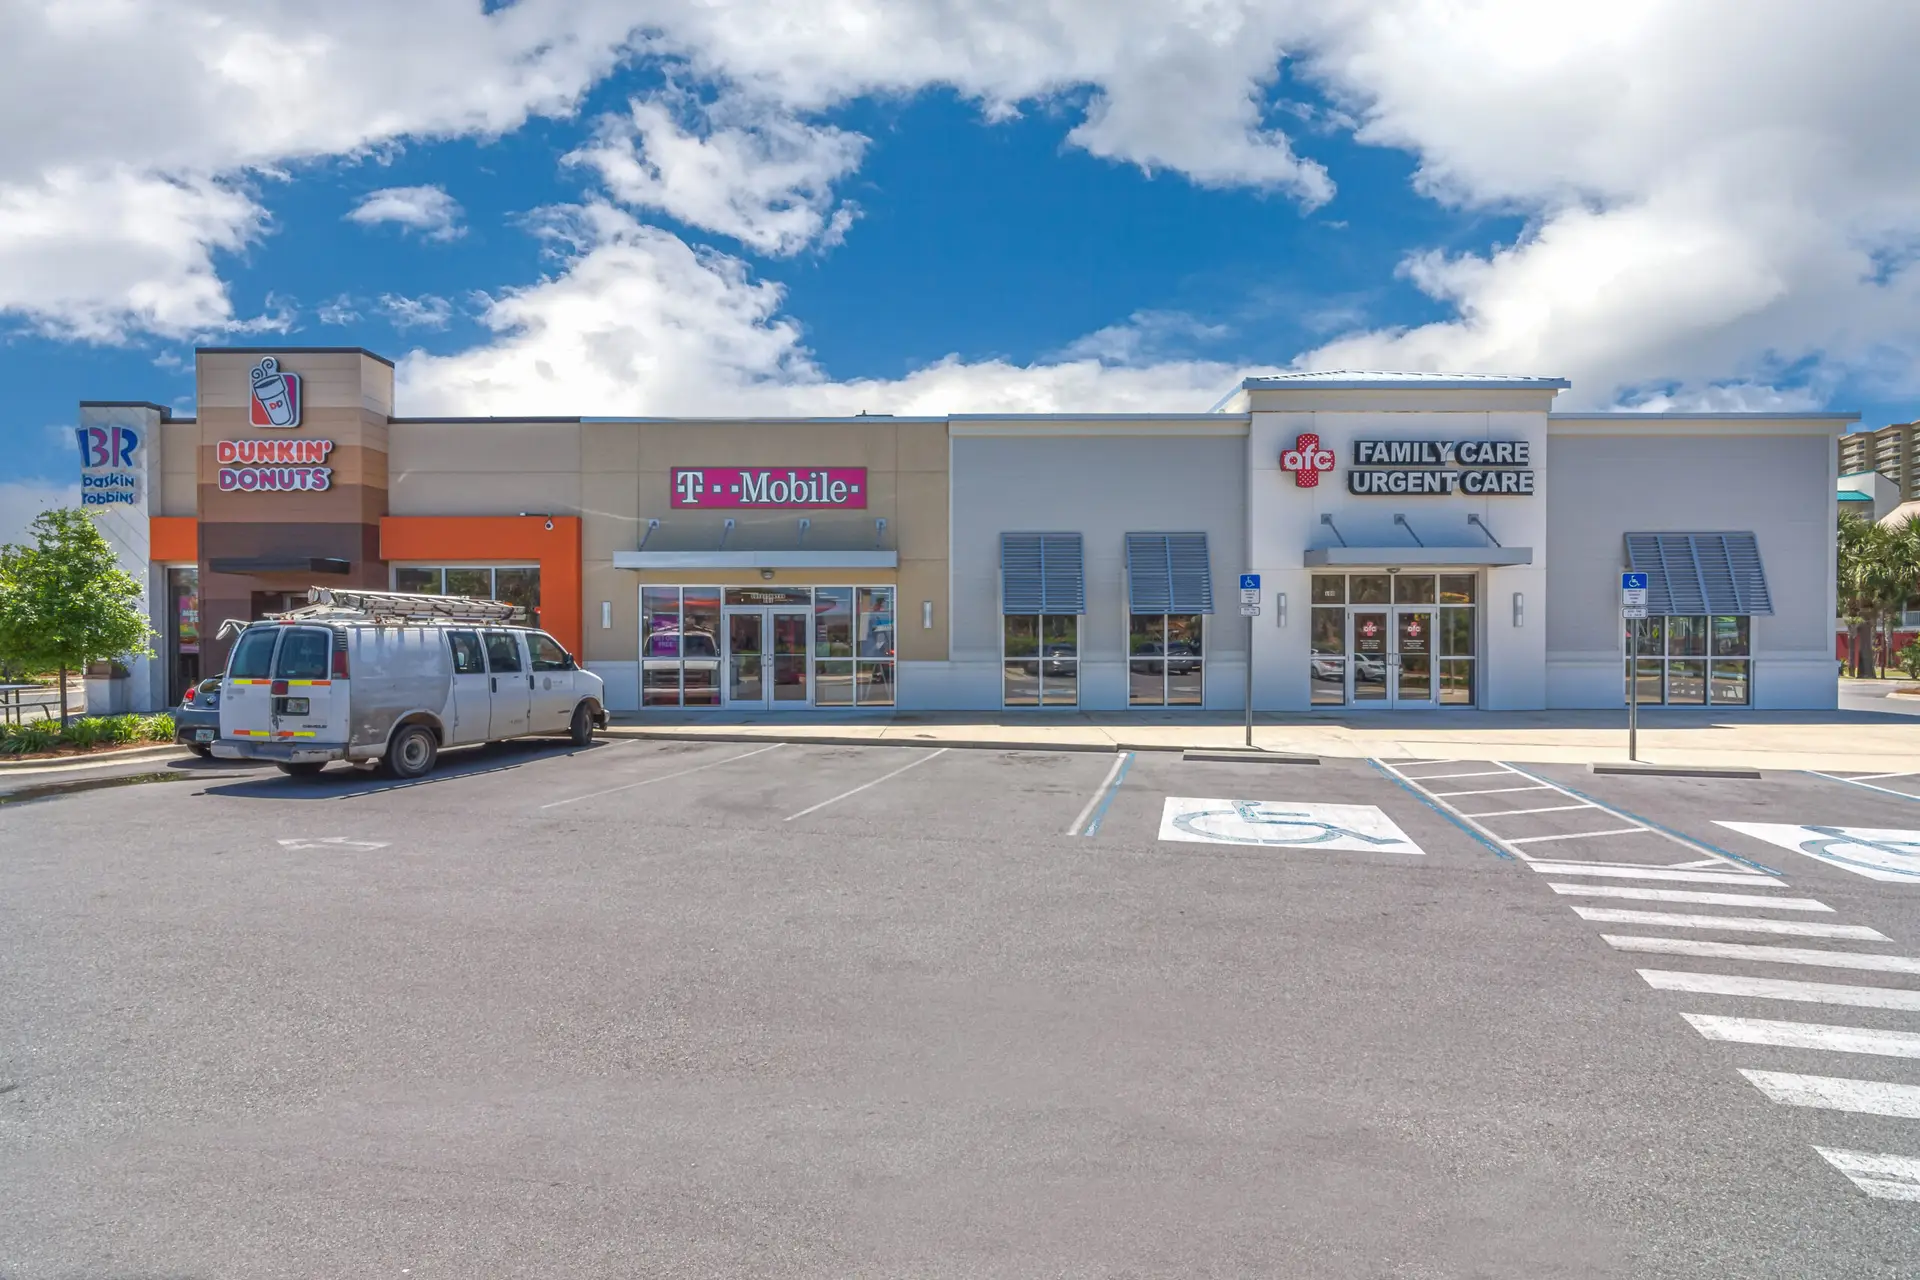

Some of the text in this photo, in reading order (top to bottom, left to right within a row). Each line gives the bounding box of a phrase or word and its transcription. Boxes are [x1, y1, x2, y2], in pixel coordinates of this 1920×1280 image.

[269, 400, 283, 410] DD
[77, 427, 138, 467] BR
[218, 441, 331, 463] DUNKIN'
[1284, 443, 1332, 470] afc
[1359, 442, 1530, 463] FAMILY CARE
[82, 472, 135, 488] baskin
[219, 468, 328, 490] DONUTS
[1353, 471, 1534, 492] URGENT CARE
[82, 491, 134, 505] robbins
[1363, 624, 1377, 632] afc
[1407, 624, 1421, 632] afc
